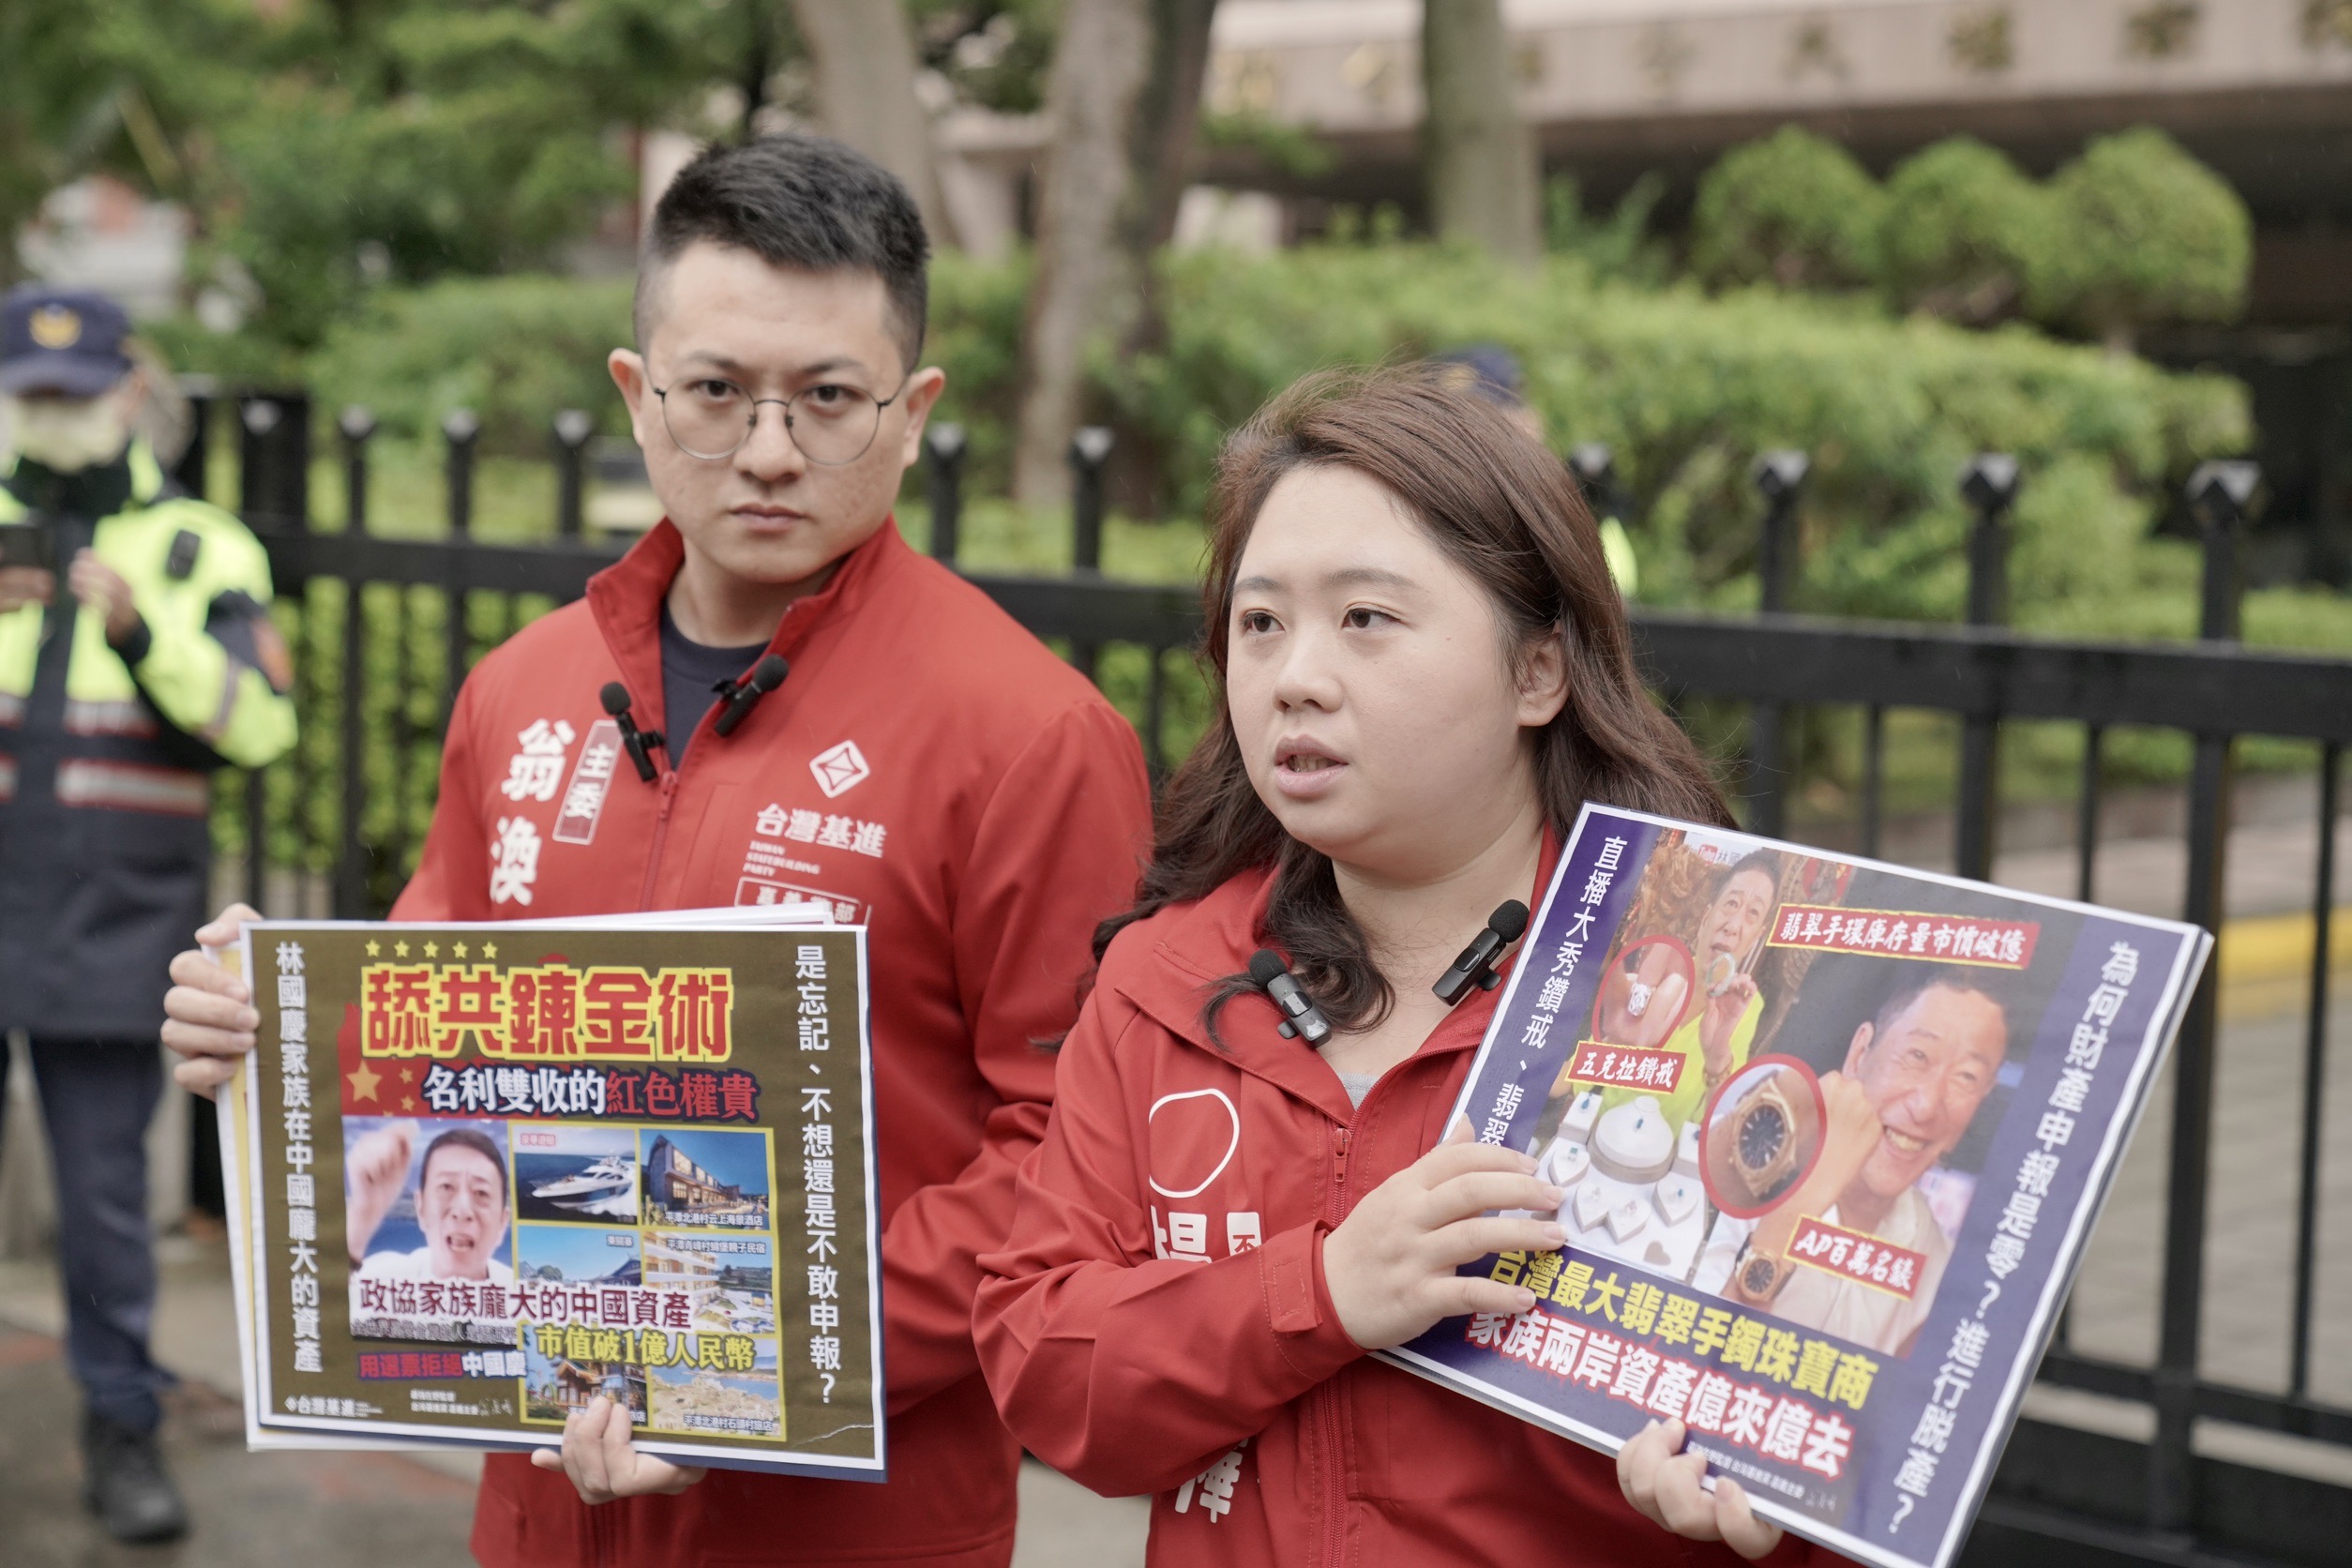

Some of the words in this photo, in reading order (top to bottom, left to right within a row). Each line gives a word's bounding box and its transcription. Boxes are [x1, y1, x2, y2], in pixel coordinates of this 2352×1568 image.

[564, 743, 614, 820] 主委
[755, 803, 887, 859] 台灣基進
[363, 965, 733, 1061] 舔共鍊金術
[422, 1064, 758, 1120] 名利雙收的紅色權貴
[1576, 1051, 1678, 1088] 五克拉鑽戒
[276, 941, 324, 1373] 林國慶家族在中國龐大的資產
[1794, 1229, 1914, 1291] AP百萬名錶
[359, 1278, 692, 1329] 政協家族龐大的中國資產
[1488, 1250, 1879, 1410] 台灣最大翡翠手鐲珠寶商
[535, 1324, 756, 1371] 市值破1億人民幣
[1469, 1307, 1854, 1478] 家族兩岸資產億來億去
